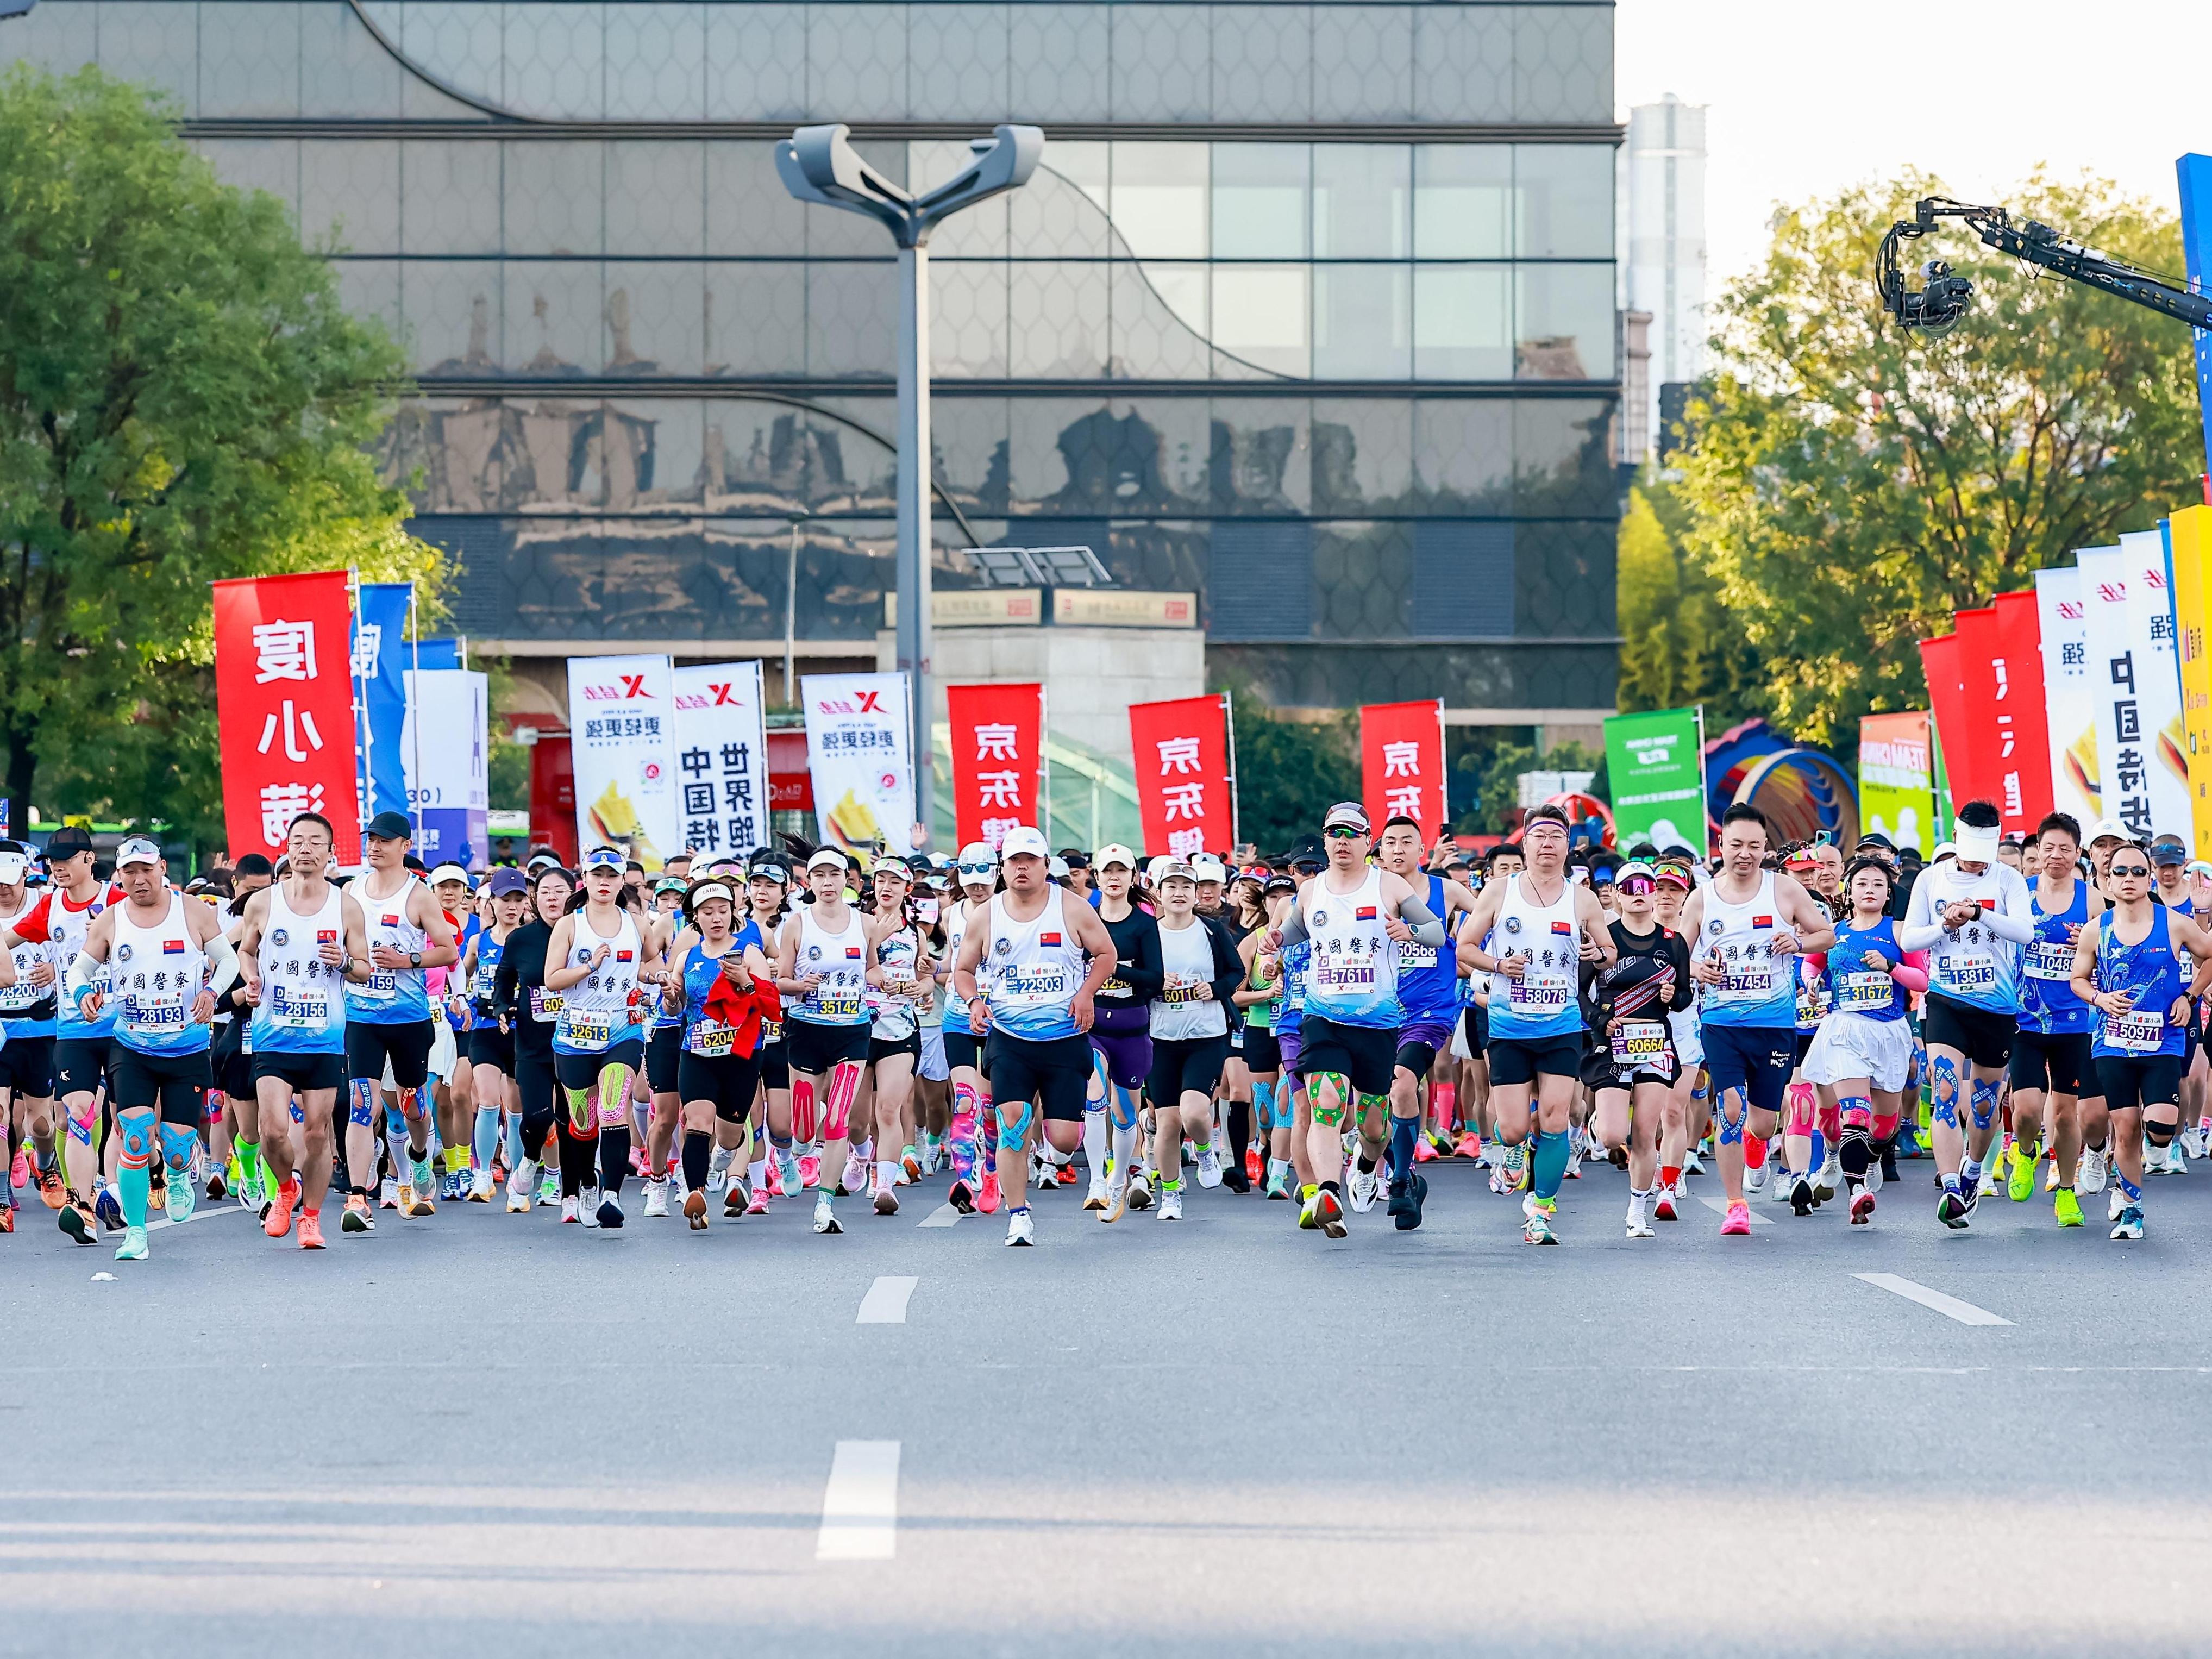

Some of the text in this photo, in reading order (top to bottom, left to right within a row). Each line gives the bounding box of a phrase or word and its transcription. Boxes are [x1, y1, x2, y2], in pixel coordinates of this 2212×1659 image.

[1939, 927, 2000, 944] 國警察
[1314, 937, 1382, 957] 中國警察
[2031, 942, 2038, 950] D
[1942, 959, 1949, 967] D
[820, 971, 859, 987] 國警察
[1009, 967, 1016, 976] D
[1330, 968, 1370, 984] 57611
[1953, 968, 1994, 984] 13813
[119, 971, 189, 991] 中國警察
[575, 976, 631, 993] 國警察
[1020, 976, 1062, 994] 22903
[1730, 975, 1770, 990] 57454
[1840, 976, 1847, 985] D
[128, 996, 135, 1005] D
[277, 988, 284, 998] D
[533, 988, 540, 997] D
[1525, 989, 1566, 1003] 58078
[1852, 985, 1892, 1001] 31672
[140, 1007, 183, 1023] 28193
[284, 1003, 325, 1017] 28156
[819, 1000, 859, 1015] 35142
[571, 1024, 608, 1041] 32613
[695, 1023, 701, 1031] D
[1615, 1028, 1622, 1037] D
[2120, 1024, 2160, 1041] 50971
[704, 1030, 738, 1048] 6204
[1627, 1038, 1664, 1054] 60664
